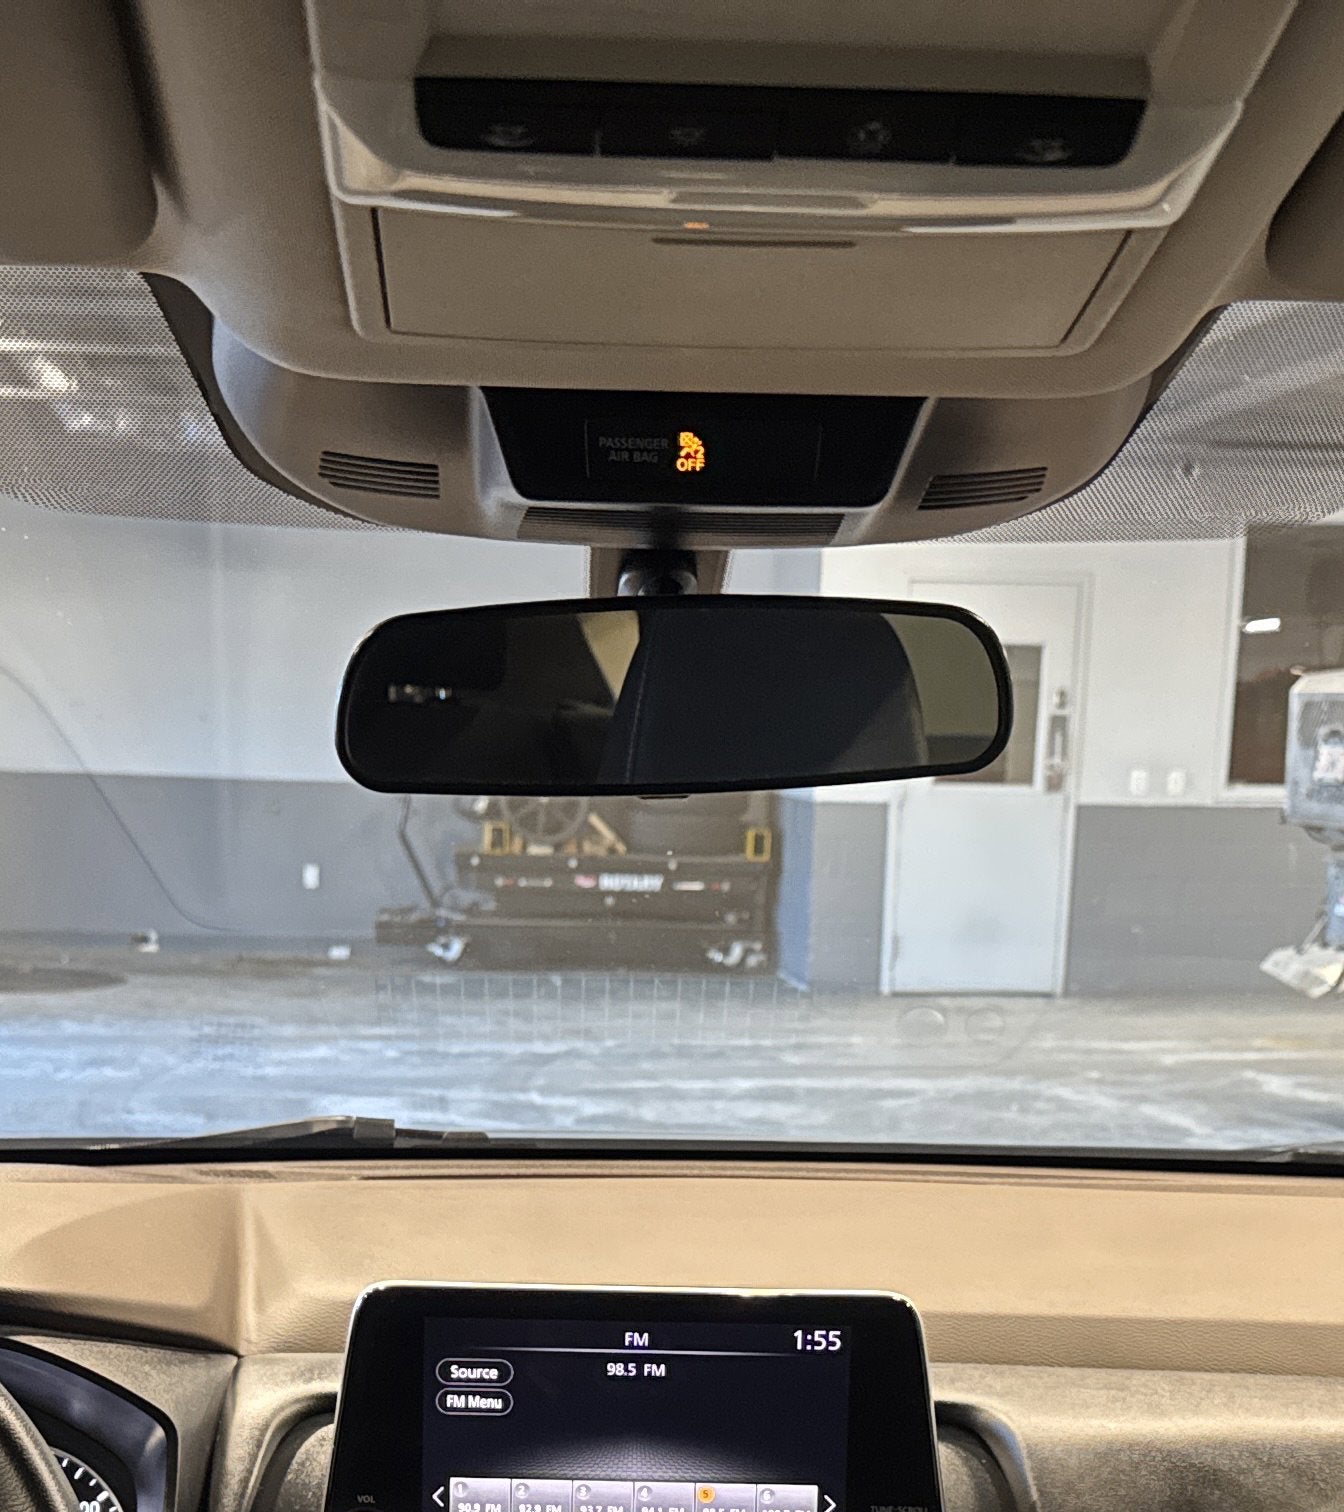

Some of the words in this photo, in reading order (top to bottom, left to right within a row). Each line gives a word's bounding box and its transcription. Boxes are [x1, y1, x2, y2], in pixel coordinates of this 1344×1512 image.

[599, 436, 670, 449] PASSENGER
[608, 450, 630, 462] AIR
[633, 451, 659, 463] BAG
[676, 458, 706, 472] OFF
[624, 1331, 650, 1347] FM
[792, 1328, 843, 1352] 1:55
[449, 1364, 500, 1380] Source
[606, 1361, 637, 1377] 98.5
[643, 1363, 666, 1378] FM
[446, 1394, 466, 1409] FM
[467, 1395, 503, 1410] Menu
[357, 1494, 375, 1504] VOL
